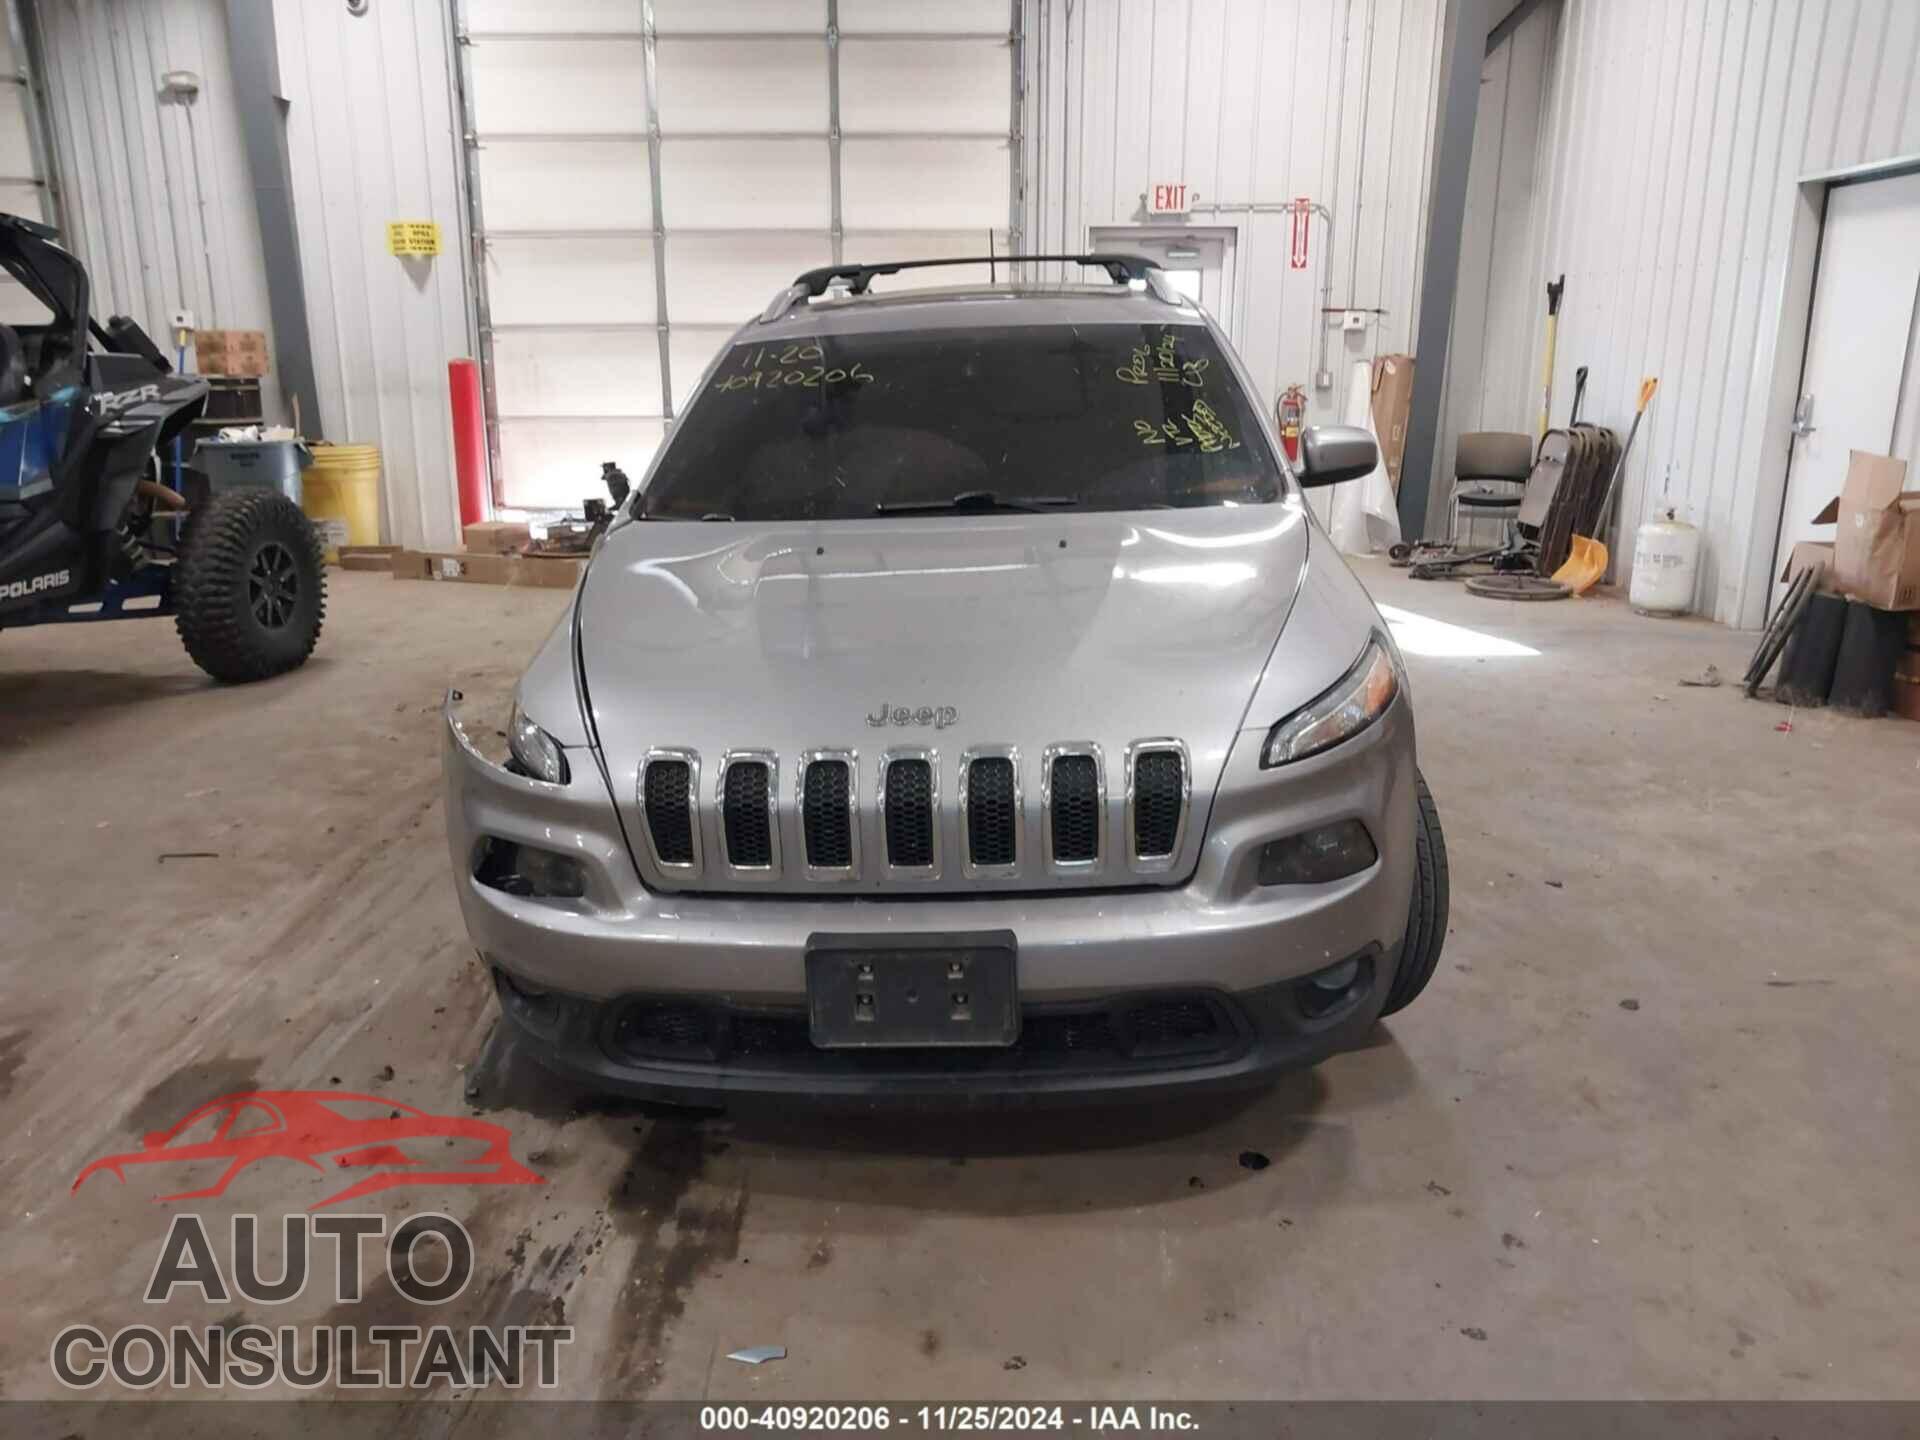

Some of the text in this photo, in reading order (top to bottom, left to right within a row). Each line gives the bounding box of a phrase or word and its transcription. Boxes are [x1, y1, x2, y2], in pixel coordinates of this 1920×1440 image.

[1155, 185, 1187, 211] EXIT
[94, 384, 161, 416] RZR
[0, 569, 70, 598] POLARIS
[866, 701, 958, 730] Jeep
